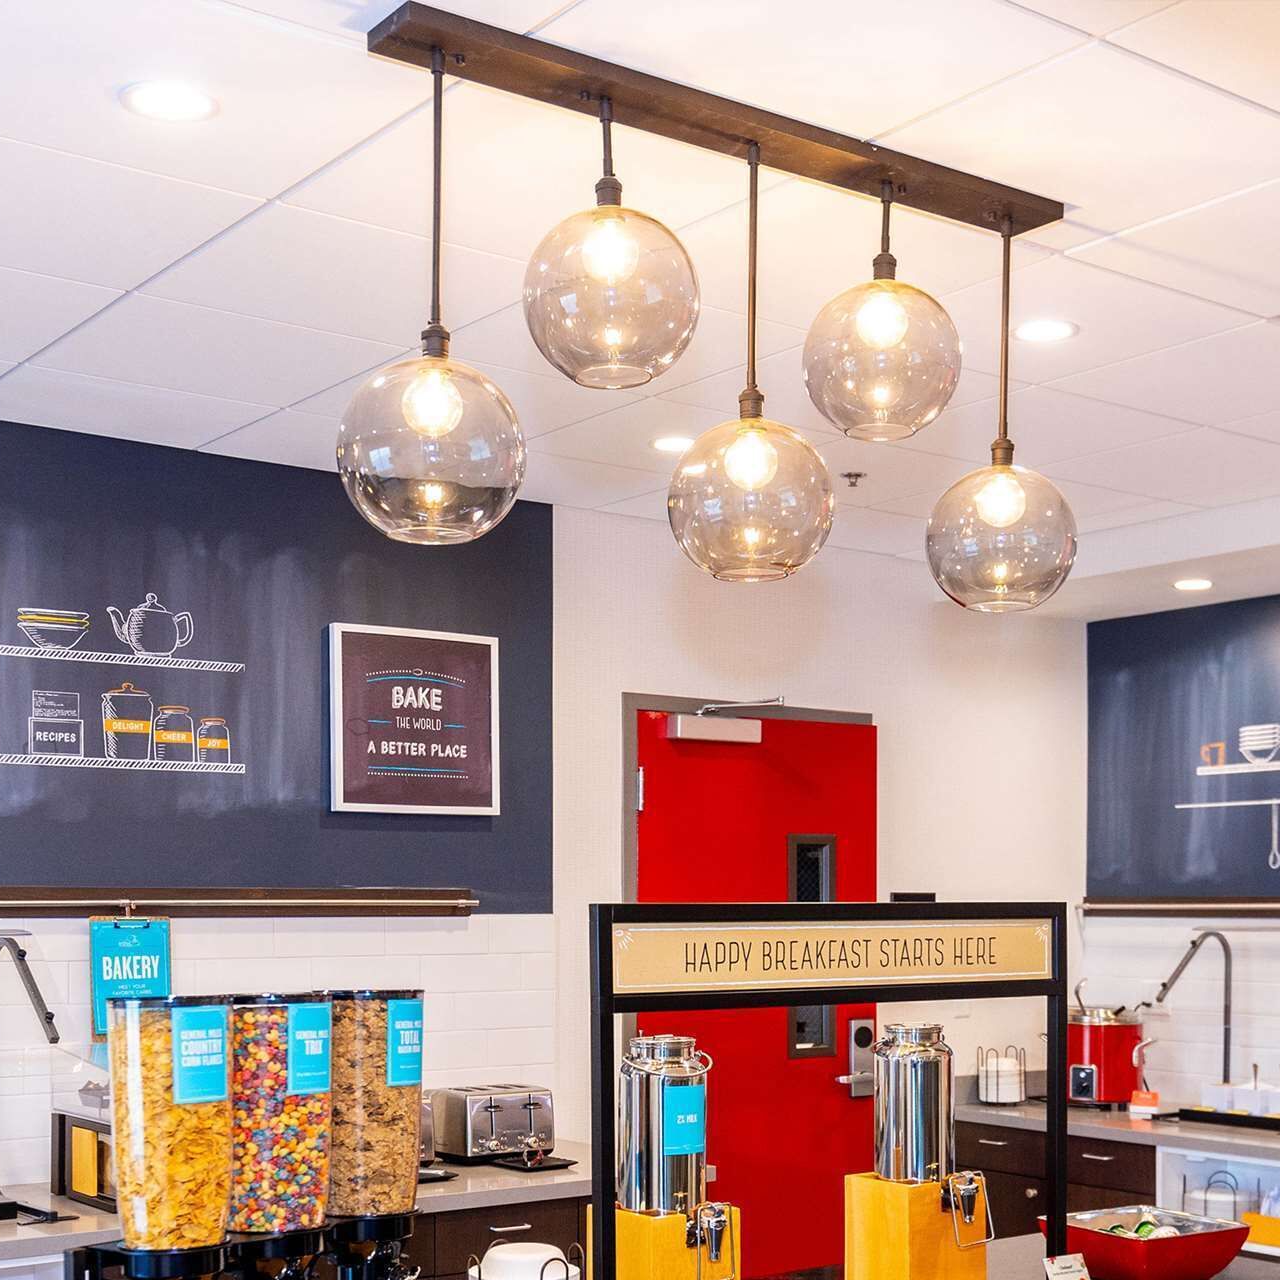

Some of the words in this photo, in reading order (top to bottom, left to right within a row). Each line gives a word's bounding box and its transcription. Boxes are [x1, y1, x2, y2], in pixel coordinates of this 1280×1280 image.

[391, 686, 443, 711] BAKE
[112, 721, 145, 731] DELIGHT
[396, 716, 410, 729] THE
[412, 717, 442, 731] WORLD
[35, 731, 77, 743] RECIPES
[207, 739, 221, 748] JOY
[367, 740, 376, 754] A
[381, 741, 426, 756] BETTER
[430, 744, 468, 758] PLACE
[684, 941, 752, 973] HAPPY
[762, 938, 872, 972] BREAKFAST
[879, 936, 945, 968] STARTS
[953, 936, 998, 966] HERE
[102, 955, 160, 980] BAKERY
[181, 1029, 207, 1040] GENERAL
[400, 1030, 419, 1045] TOTAL
[181, 1038, 222, 1055] COUNTRY
[304, 1039, 323, 1055] TRIX
